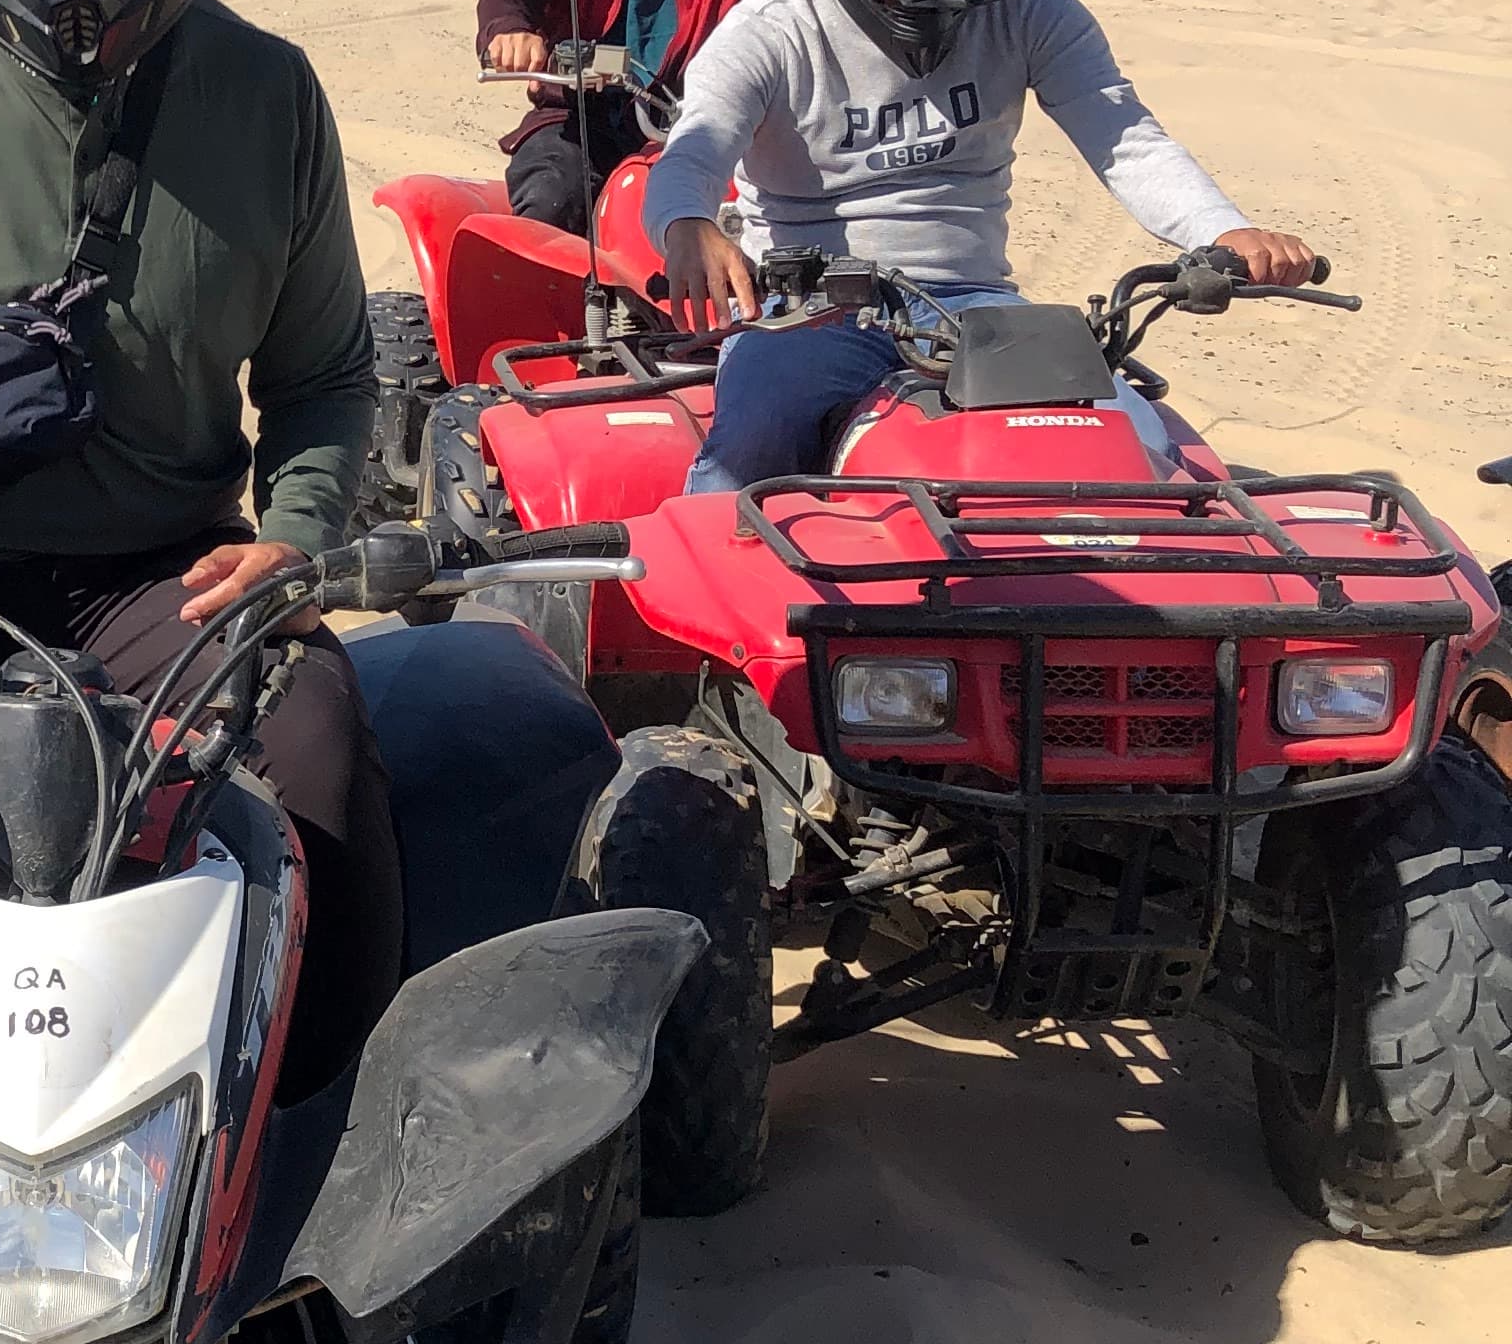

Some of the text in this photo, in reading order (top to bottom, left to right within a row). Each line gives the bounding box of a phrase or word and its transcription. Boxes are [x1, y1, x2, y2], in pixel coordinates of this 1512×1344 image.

[840, 82, 980, 149] POLO
[881, 141, 944, 169] 1967
[1006, 415, 1105, 427] HONDA
[14, 966, 66, 990] QA
[8, 1006, 70, 1038] 108
